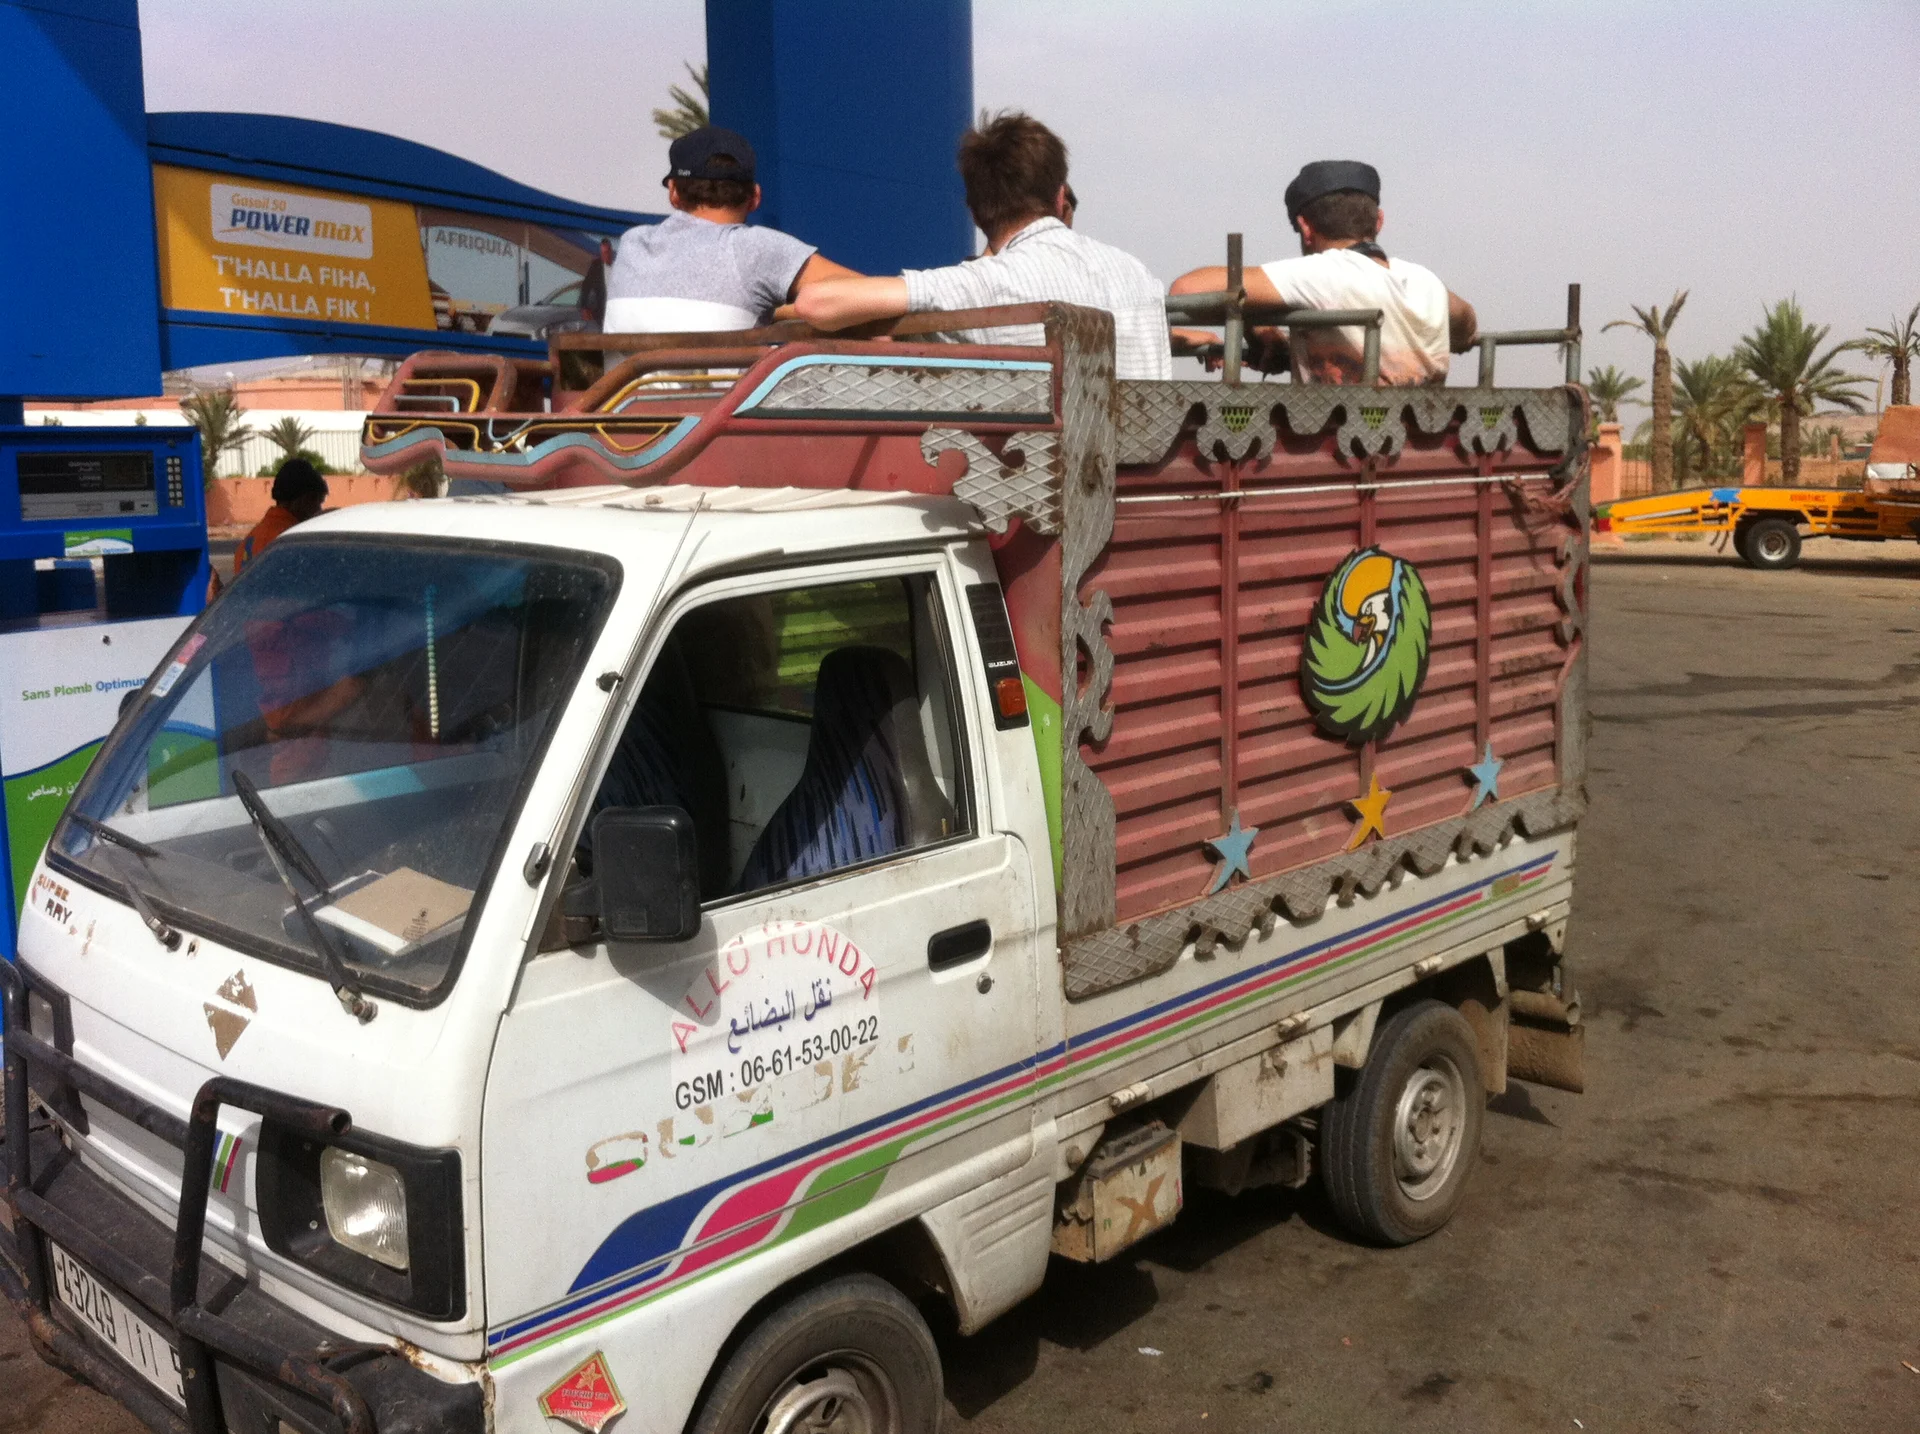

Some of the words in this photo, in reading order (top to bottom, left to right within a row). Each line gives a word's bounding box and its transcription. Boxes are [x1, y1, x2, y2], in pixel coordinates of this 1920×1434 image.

[231, 193, 270, 209] Gasoil
[271, 199, 287, 212] 50
[231, 208, 310, 236] POWER
[313, 220, 367, 244] max
[434, 229, 514, 258] AFRIQUIA
[211, 254, 315, 285] T'HALLA
[319, 265, 377, 295] FIHA,
[219, 286, 320, 316] T'HALLA
[325, 297, 360, 320] FIK
[22, 687, 51, 701] Sans
[53, 682, 93, 698] Plomb
[671, 938, 751, 1054] ALLO
[762, 922, 875, 1000] HONDA
[804, 977, 833, 1022] نقل
[727, 989, 797, 1055] البضائع
[675, 1069, 724, 1111] GSM
[741, 1016, 879, 1087] 06-61-53-00-22
